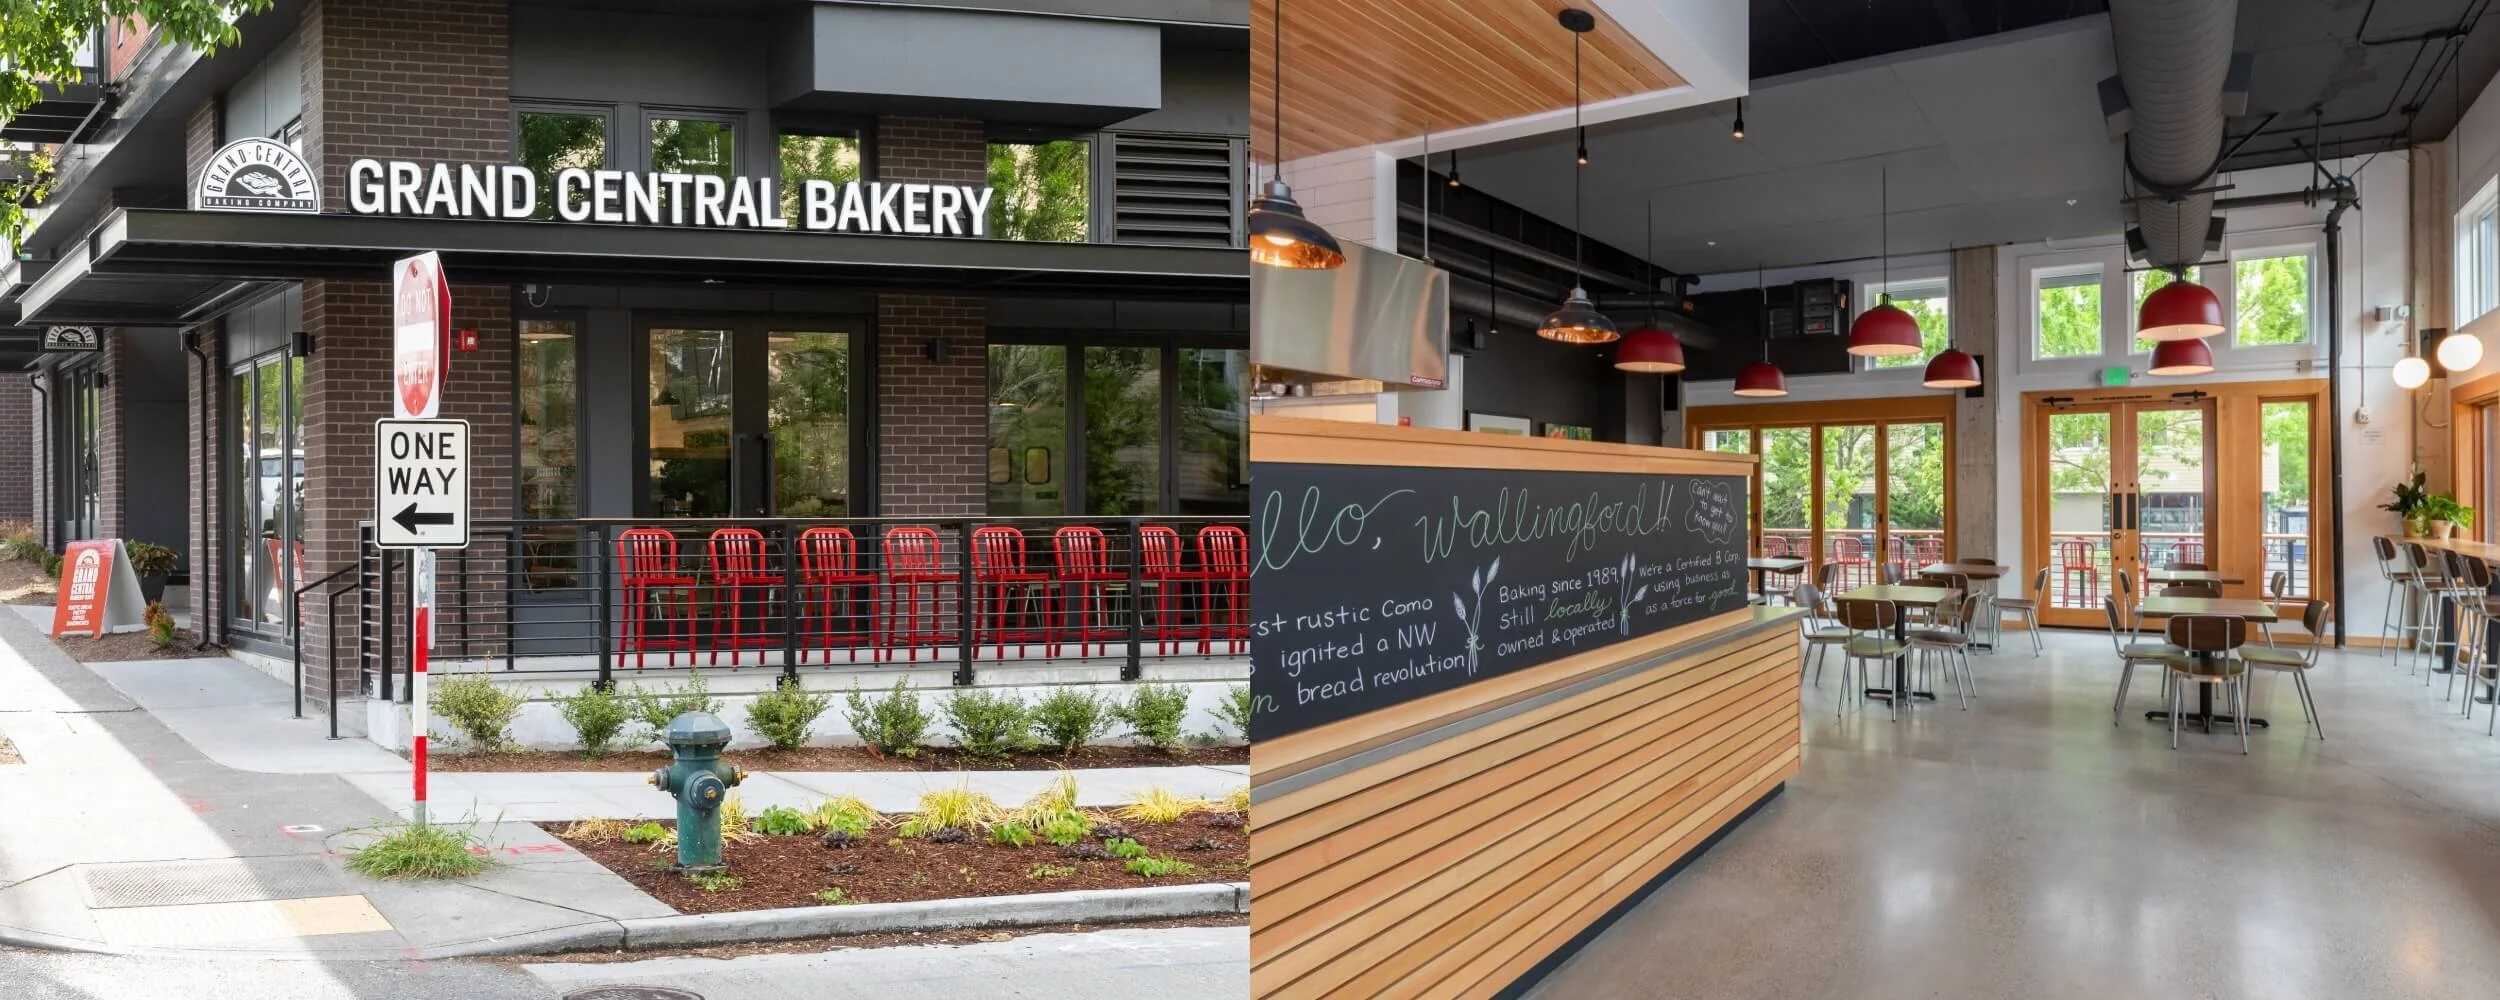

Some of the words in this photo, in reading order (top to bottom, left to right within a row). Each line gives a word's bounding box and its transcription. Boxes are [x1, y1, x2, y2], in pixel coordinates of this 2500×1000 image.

[206, 149, 247, 193] GRAND
[256, 144, 311, 196] CENTRAL
[206, 197, 250, 206] BAKING
[258, 199, 313, 208] COMPANY
[350, 158, 536, 218] GRAND
[557, 168, 788, 228] CENTRAL
[806, 179, 994, 236] BAKERY
[401, 293, 411, 314] DO
[416, 287, 431, 313] NOT
[403, 360, 428, 386] ENTER
[390, 431, 456, 460] ONE
[388, 466, 458, 495] WAY
[1665, 563, 1672, 572] a
[1676, 554, 1711, 571] Certified
[1716, 550, 1721, 565] B
[1500, 584, 1546, 603] Baking
[1552, 579, 1582, 594] since
[1654, 579, 1680, 594] using
[1685, 572, 1718, 585] business
[1721, 569, 1730, 579] as
[1297, 606, 1370, 631] rustic
[1382, 598, 1433, 617] Como
[1500, 604, 1534, 630] Still
[1544, 590, 1613, 621] locally
[1645, 603, 1658, 615] as
[1661, 602, 1668, 611] a
[1670, 593, 1693, 608] force
[1695, 591, 1706, 603] for
[1497, 628, 1544, 656] owned
[1552, 628, 1561, 644] &
[1563, 613, 1616, 647] operated
[1281, 633, 1364, 678] ignited
[1377, 638, 1389, 651] a
[1399, 622, 1436, 650] NW
[1298, 667, 1364, 705] bread
[1374, 654, 1465, 687] revolution
